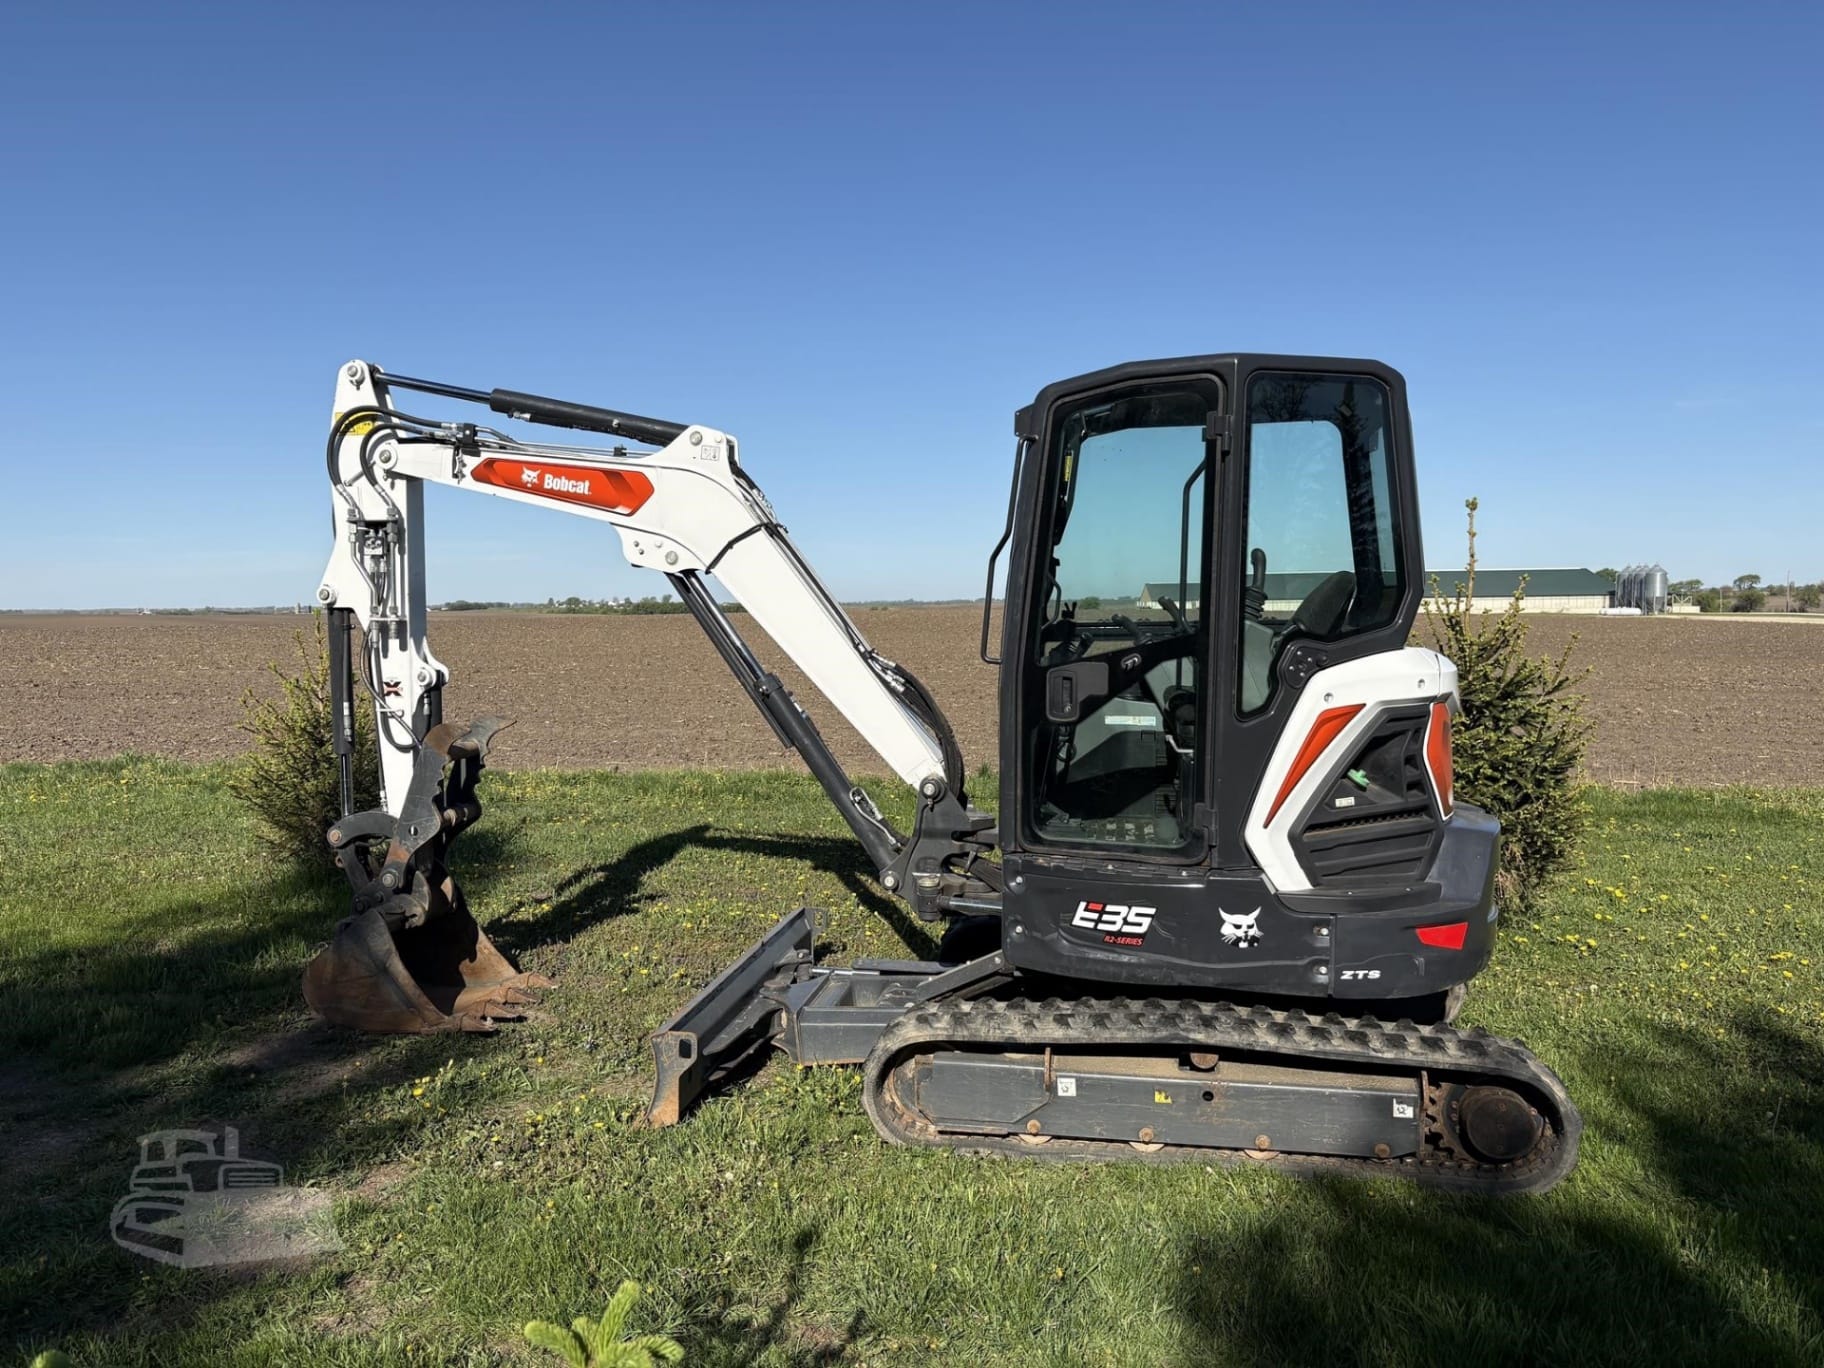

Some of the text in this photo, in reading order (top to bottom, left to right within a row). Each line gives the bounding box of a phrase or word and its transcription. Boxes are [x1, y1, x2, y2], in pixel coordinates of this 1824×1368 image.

[543, 473, 590, 496] Bobcat
[1071, 901, 1157, 933] E35
[1340, 970, 1382, 980] ZTS
